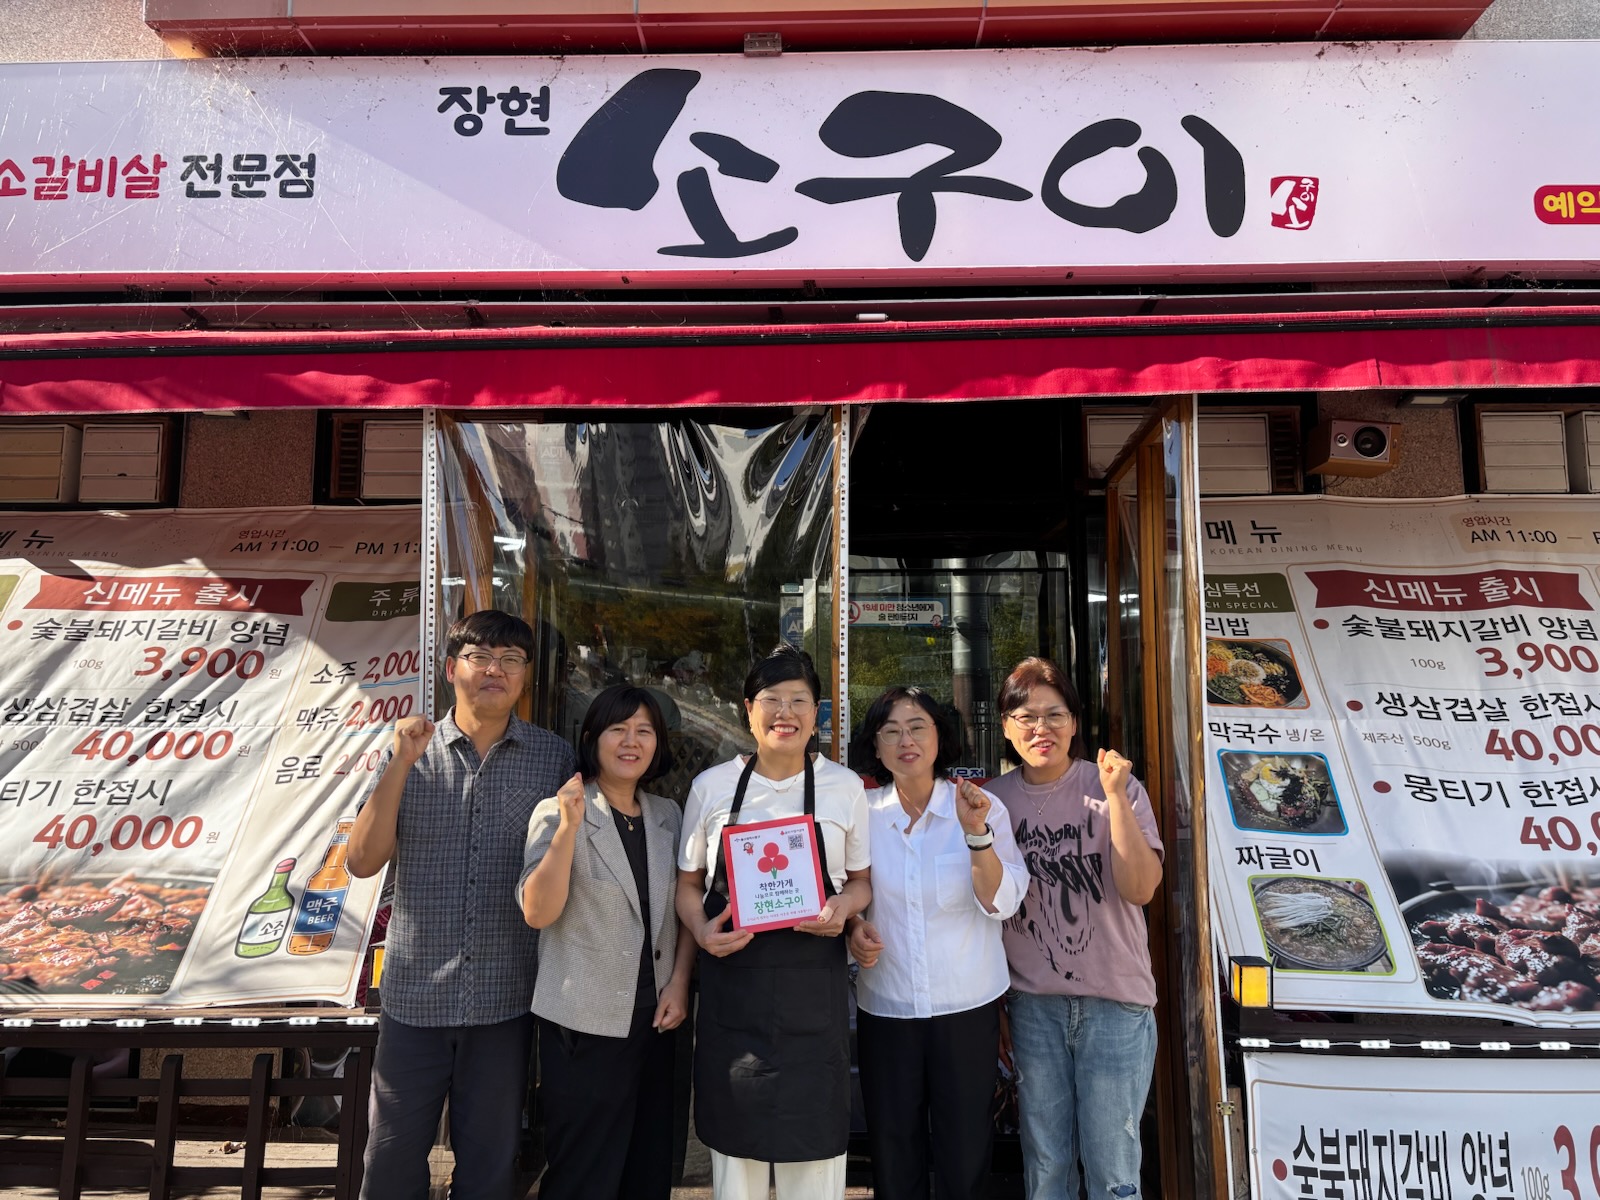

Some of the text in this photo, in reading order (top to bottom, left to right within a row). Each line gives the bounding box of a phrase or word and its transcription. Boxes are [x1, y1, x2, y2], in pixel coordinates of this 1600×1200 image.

[437, 86, 551, 136] 장현
[0, 153, 316, 201] 소갈비살 전문점
[557, 68, 1246, 262] 소구이
[238, 529, 286, 539] 영업시간
[1462, 516, 1512, 527] 영업시간
[230, 540, 421, 555] AM 11:00 PM 11:
[1210, 543, 1365, 555] KOREAN DINING MENU
[1471, 529, 1500, 543] AM
[1506, 530, 1557, 544] 11:00
[82, 582, 263, 607] 신메뉴 출시
[1362, 576, 1544, 606] 신메뉴 출시
[862, 603, 878, 612] 19세
[879, 603, 895, 612] 미만
[1226, 601, 1278, 610] SPECIAL
[30, 617, 289, 647] 숯불돼지갈비 양념
[1341, 614, 1599, 643] 숯불돼지갈비 양념
[73, 657, 103, 670] 100g
[134, 646, 265, 682] 3,900
[310, 661, 357, 685] 소주
[1410, 642, 1599, 680] 100g 3,900
[4, 697, 238, 724] 생삼겹살 한접시
[296, 694, 413, 732] 맥주 2,000
[1375, 691, 1510, 722] 생삼겹살
[1208, 722, 1325, 745] 막국수 냉/온
[1361, 731, 1404, 746] 제주산
[1413, 734, 1452, 751] 500g
[71, 729, 234, 766] 40,000
[275, 755, 323, 785] 음료
[73, 779, 173, 806] 한접시
[1403, 773, 1511, 808] 뭉티기
[33, 814, 203, 857] 40,000
[1235, 845, 1321, 872] 짜글이
[759, 879, 793, 891] 착한가게
[305, 897, 339, 914] 맥주
[754, 895, 804, 914] 장현소구이
[259, 920, 285, 938] 소주
[307, 913, 334, 926] BEER
